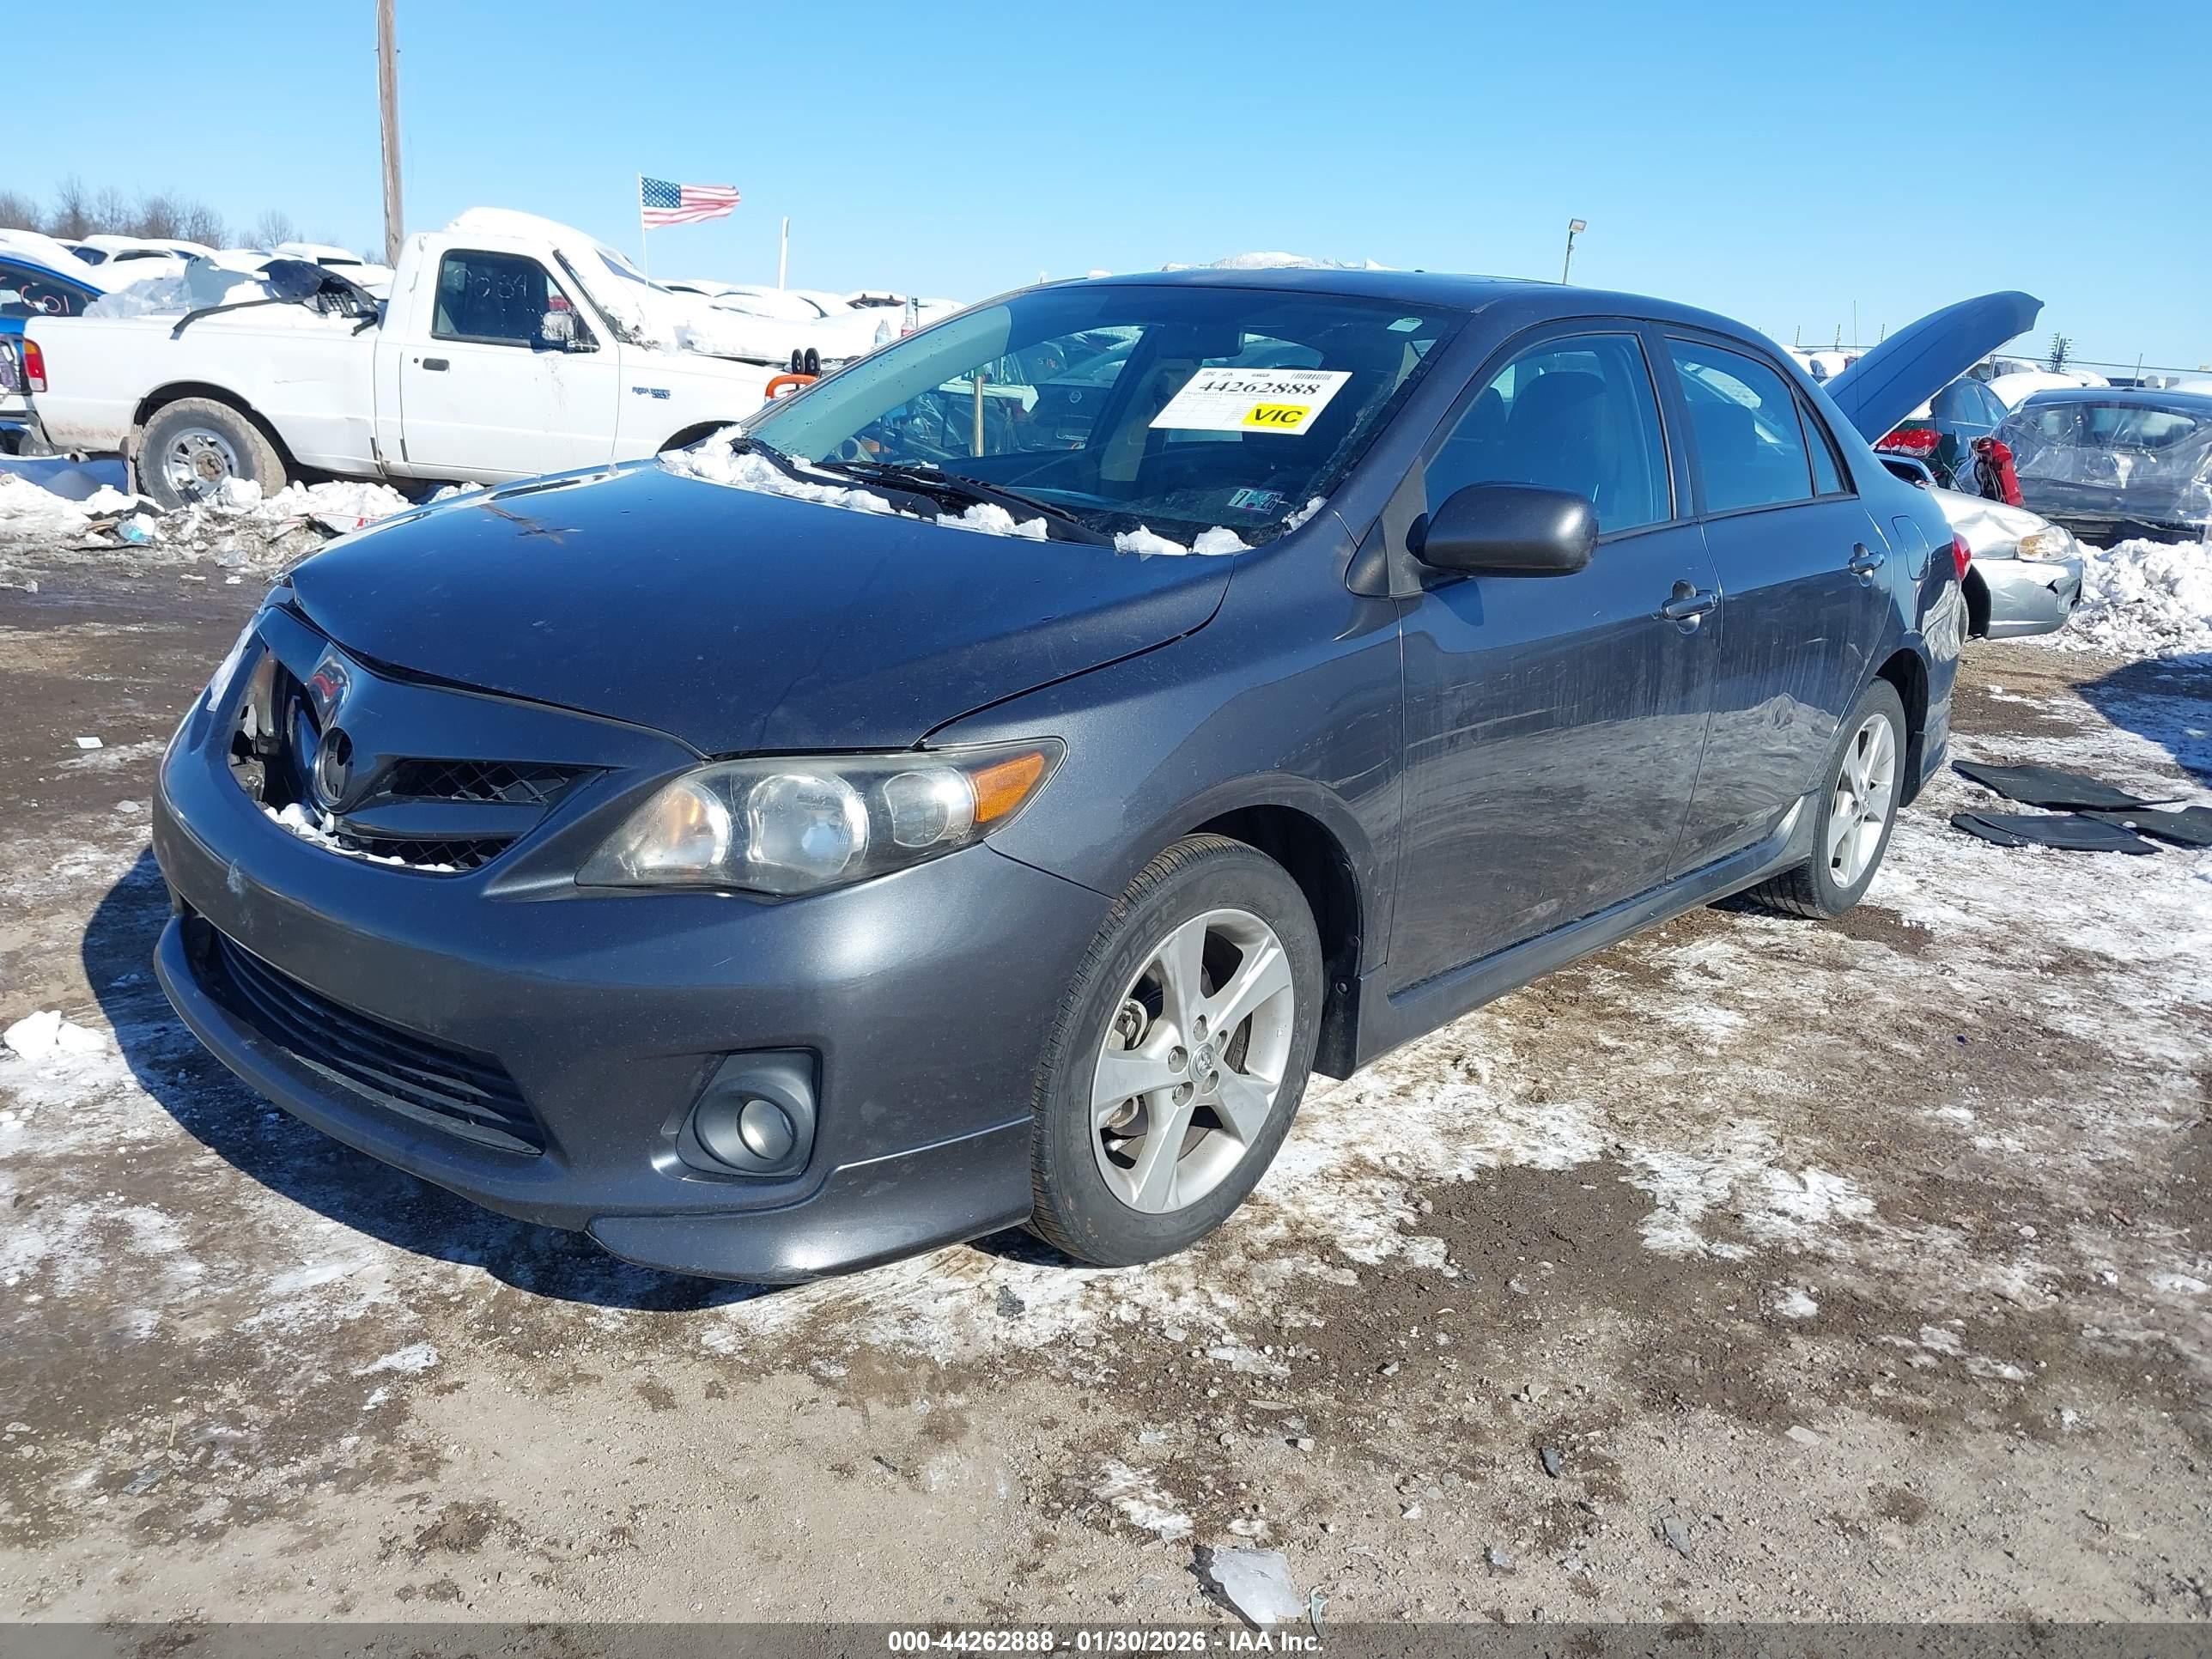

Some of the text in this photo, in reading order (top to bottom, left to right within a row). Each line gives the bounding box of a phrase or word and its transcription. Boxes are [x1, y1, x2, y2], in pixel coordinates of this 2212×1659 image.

[1199, 380, 1321, 396] 44262888
[1254, 408, 1303, 423] VIC
[1091, 896, 1177, 1027] COOPER
